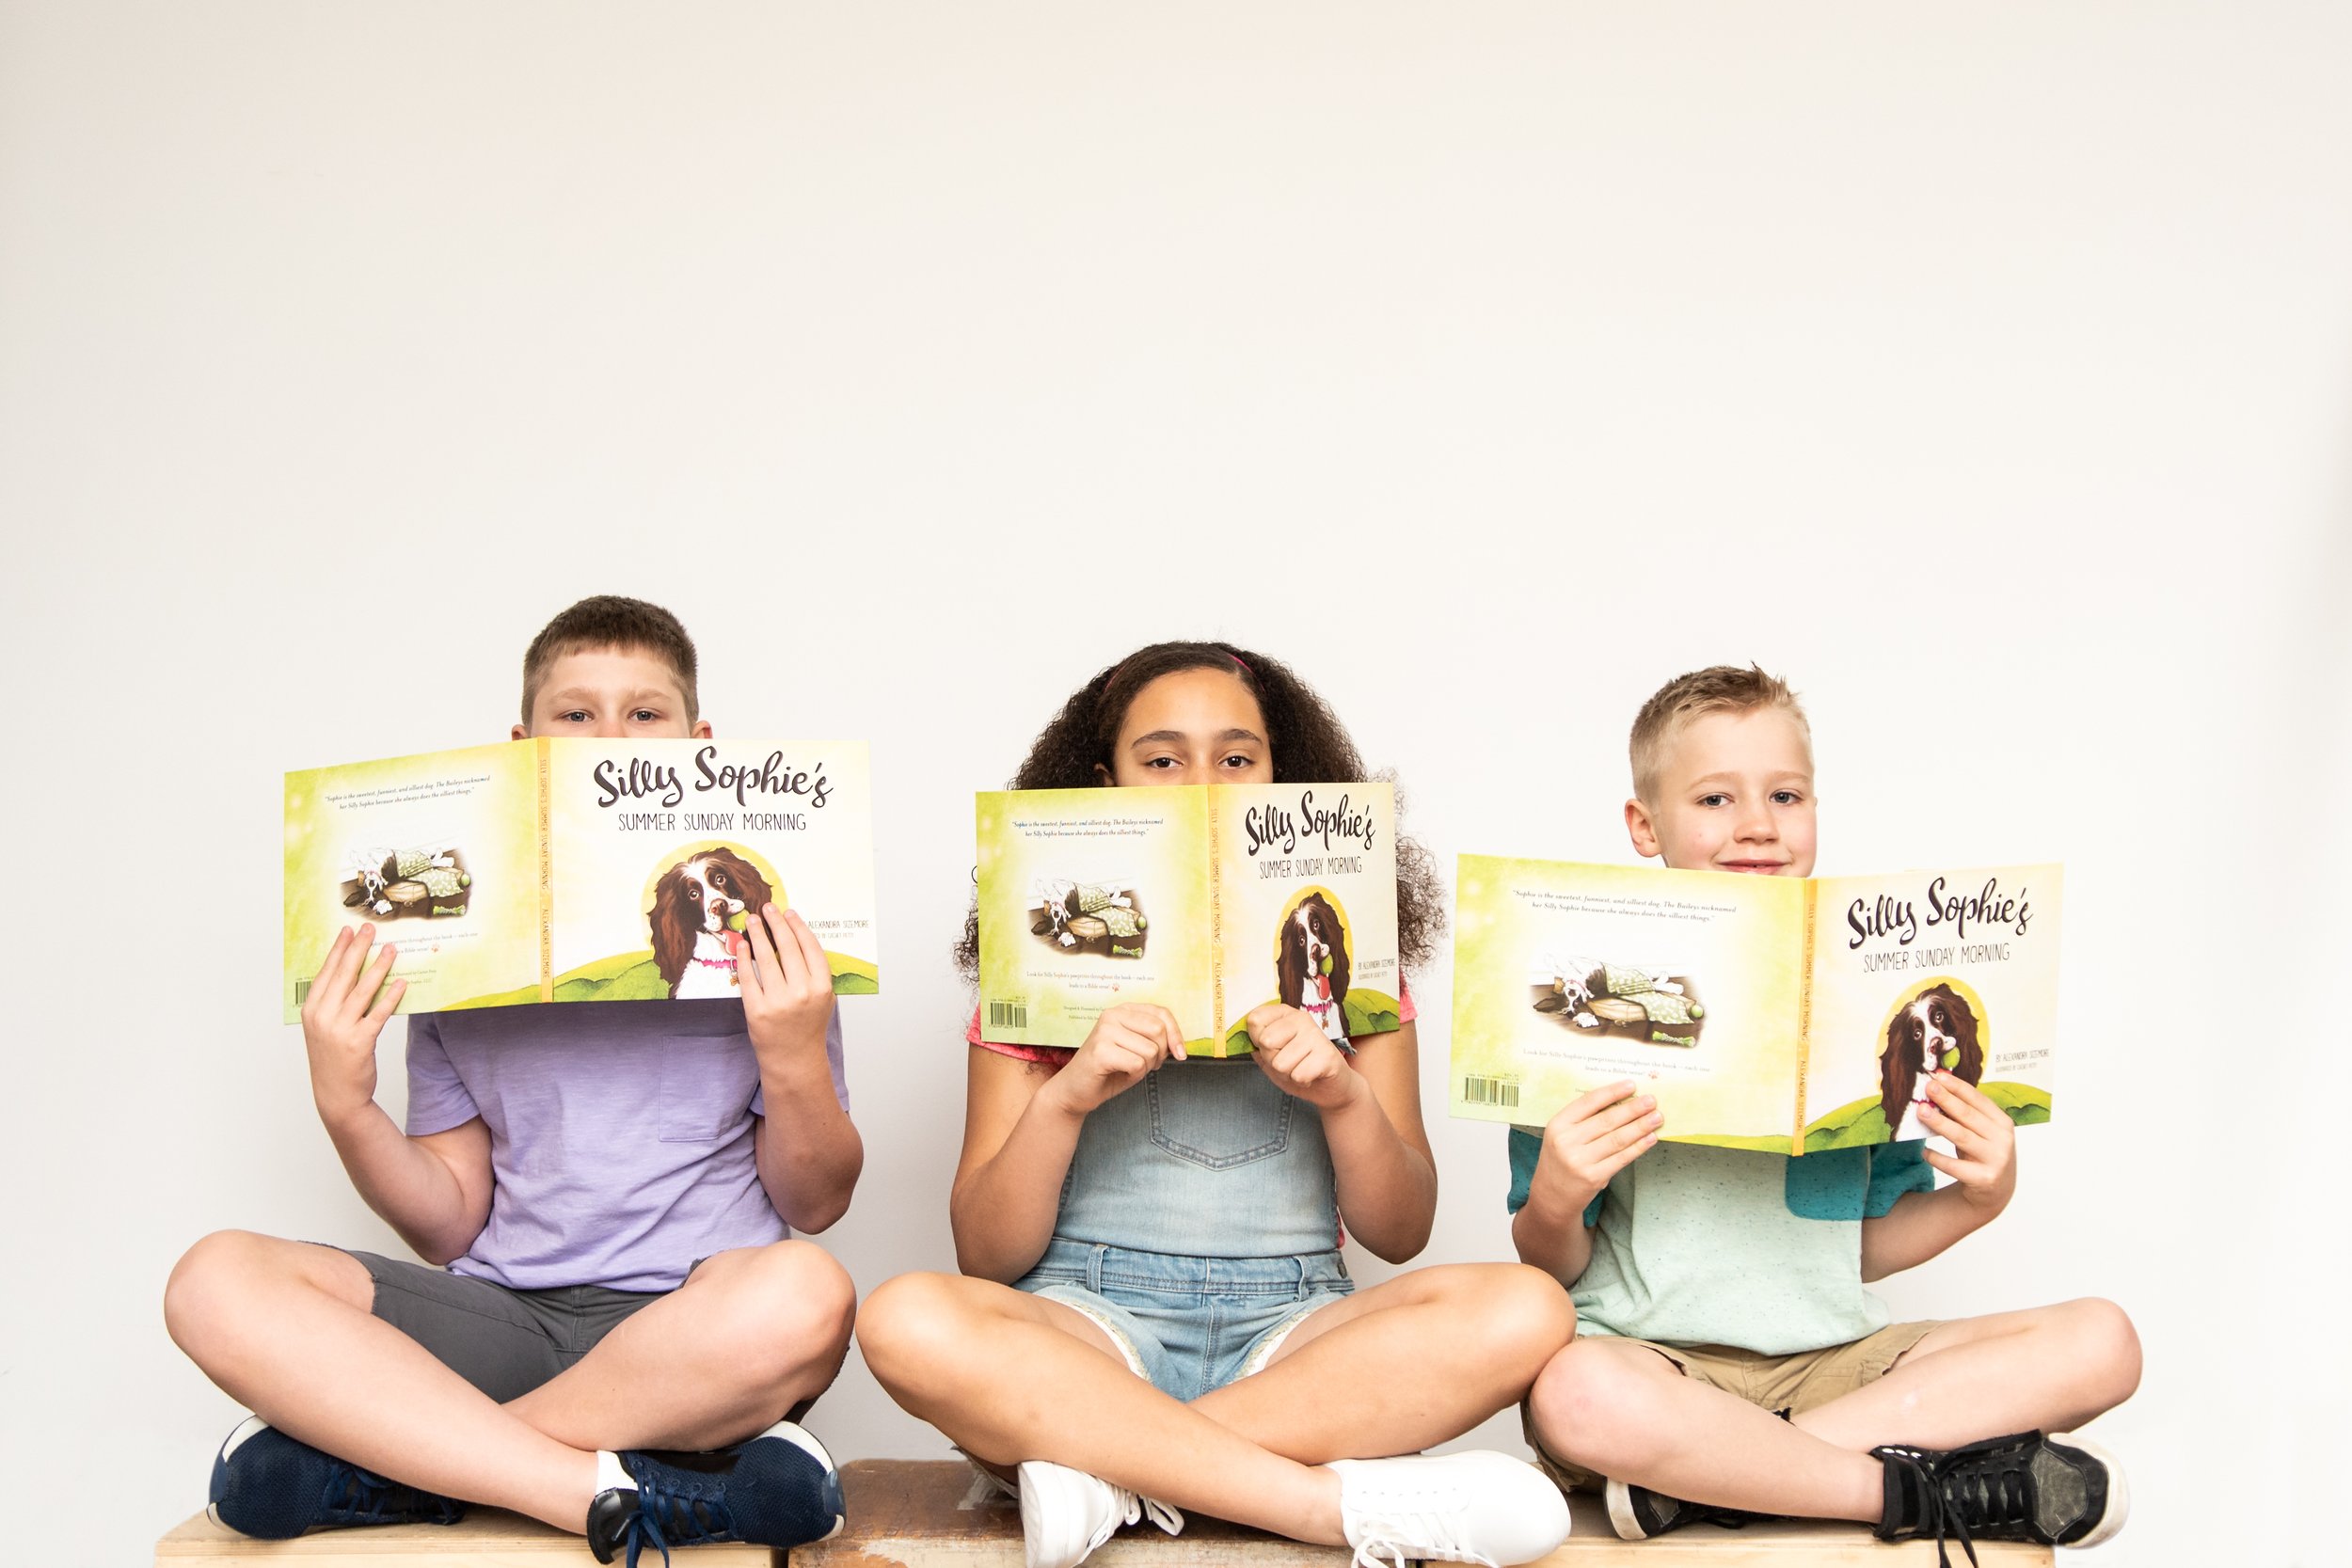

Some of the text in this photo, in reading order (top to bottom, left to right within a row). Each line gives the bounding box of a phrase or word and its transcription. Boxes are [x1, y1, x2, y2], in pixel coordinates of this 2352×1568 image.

[594, 745, 834, 808] Silly Sophie's
[618, 813, 806, 832] SUMMER SUNDAY MORNING
[1245, 790, 1375, 856] Silly Sophie's
[1260, 856, 1362, 879] SUMMER SUNDAY MORNING
[1848, 876, 2033, 950] Silly Sophie's
[1864, 942, 2010, 974] SUMMER SUNDAY MORNING
[1801, 1010, 1809, 1041] MORNING
[1798, 1061, 1806, 1098] ALEXANDRA
